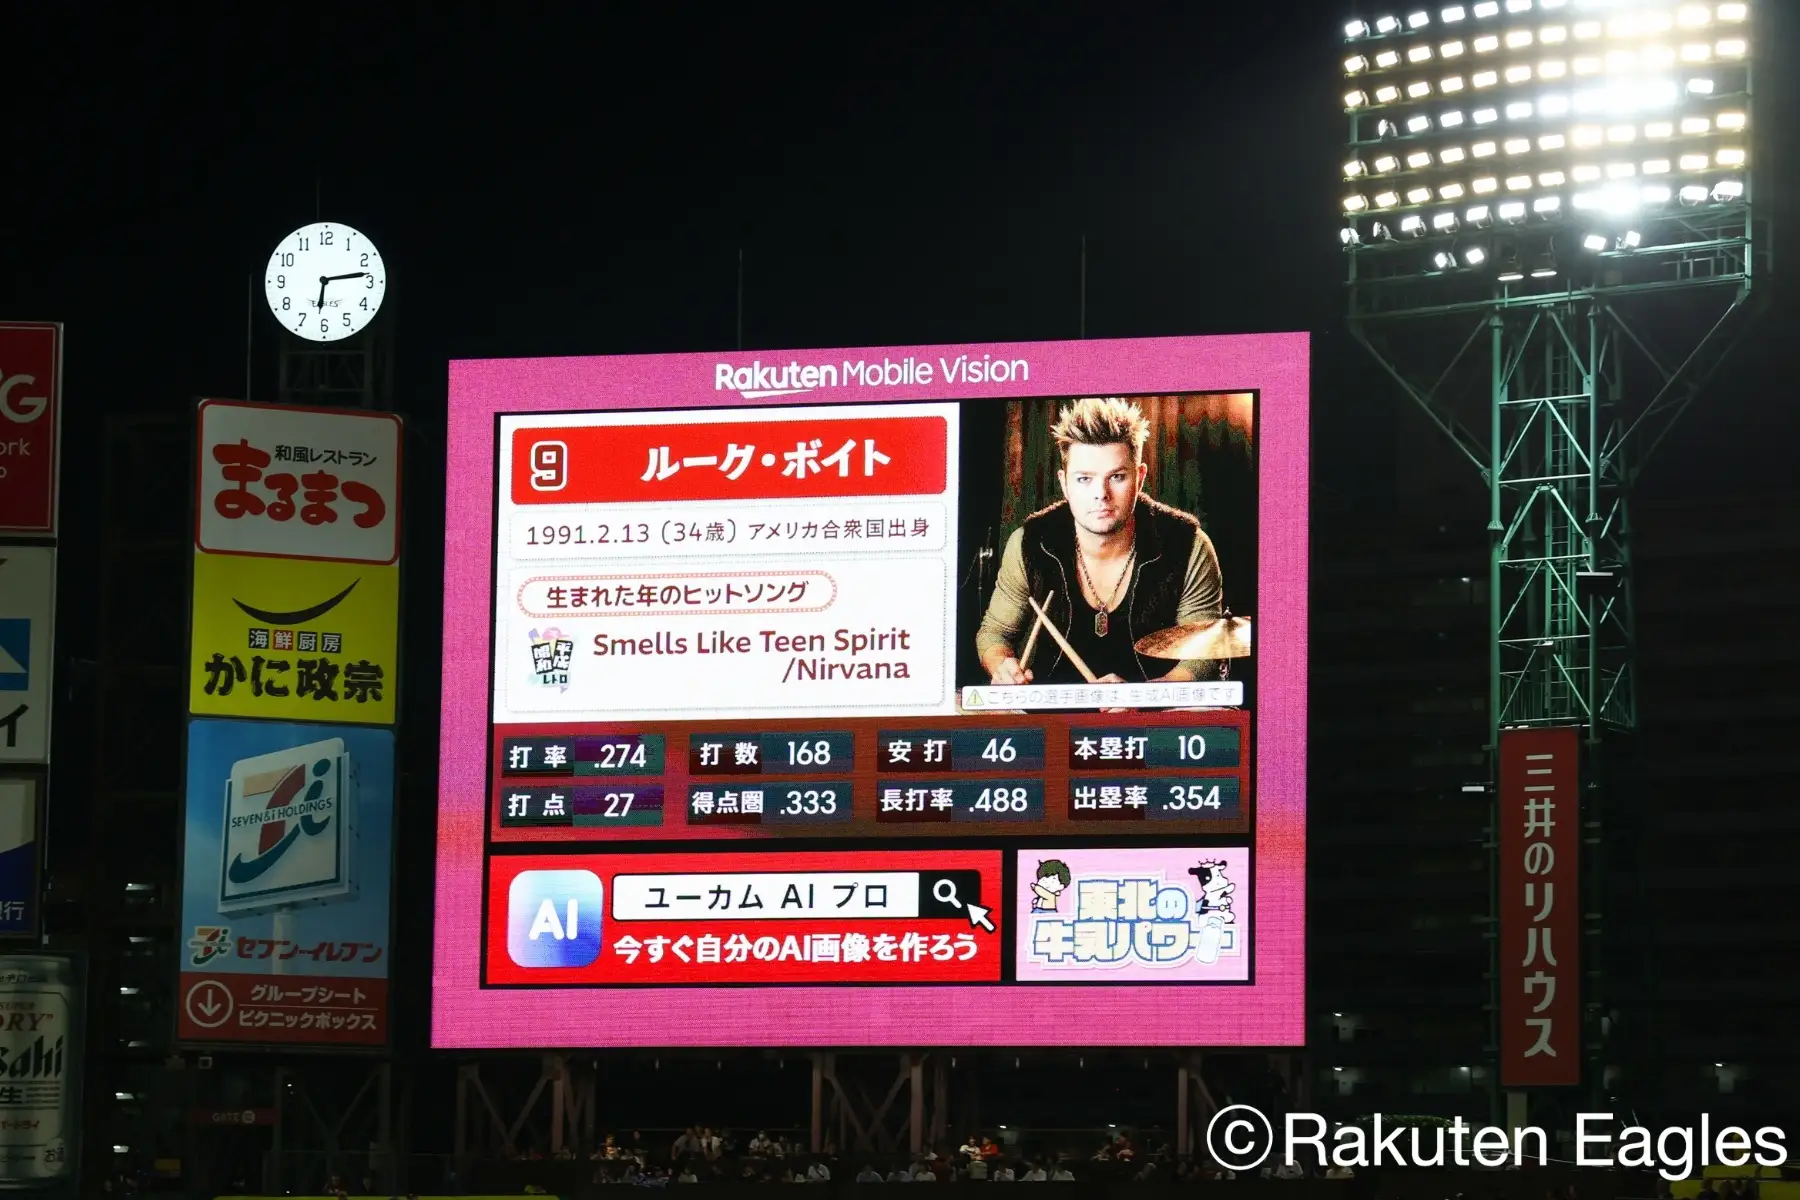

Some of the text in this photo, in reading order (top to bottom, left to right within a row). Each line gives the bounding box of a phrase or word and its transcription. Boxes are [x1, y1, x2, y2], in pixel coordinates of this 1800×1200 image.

[299, 237, 309, 251] 11
[320, 231, 333, 245] 12
[346, 237, 351, 251] 1
[281, 253, 294, 267] 10
[360, 253, 369, 267] 2
[277, 275, 285, 289] 9
[365, 275, 374, 289] 3
[282, 297, 291, 311] 8
[359, 297, 368, 311] 4
[298, 313, 307, 327] 7
[320, 319, 329, 333] 6
[342, 313, 351, 327] 5
[715, 354, 1029, 392] Rakuten Mobile Vision
[275, 444, 377, 467] 和風レストラン
[530, 440, 568, 492] 9
[640, 438, 892, 482] ルーク・ボイト
[213, 438, 386, 529] まるまつ
[526, 523, 650, 546] 1991.2.13
[748, 516, 930, 540] アメリカ合衆国出身
[546, 580, 810, 609] 生まれた年のヒットソング
[249, 627, 342, 653] 海鮮厨房
[593, 628, 910, 656] Smells Like Teen Spirit
[203, 653, 385, 704] かに政宗
[781, 657, 911, 684] /Nirvana
[509, 743, 647, 769] 打率 .274
[699, 740, 831, 766] 打数 168
[888, 738, 1017, 764] 安打 46
[1074, 734, 1206, 761] 本塁打 10
[278, 797, 333, 819] HOLDINGS
[508, 793, 635, 817] 打点 27
[691, 790, 837, 816] 得点圏 .333
[880, 787, 1029, 813] 長打率 .488
[1073, 785, 1222, 811] 出塁率 .354
[644, 881, 889, 911] ユーカム AI プロ
[1522, 753, 1557, 1058] 三井のリハウス
[528, 897, 579, 941] AI
[612, 930, 979, 965] 今すぐ自分のAI画像を作ろう
[251, 983, 367, 1006] グループシート
[238, 1009, 377, 1031] ピクニックボックス
